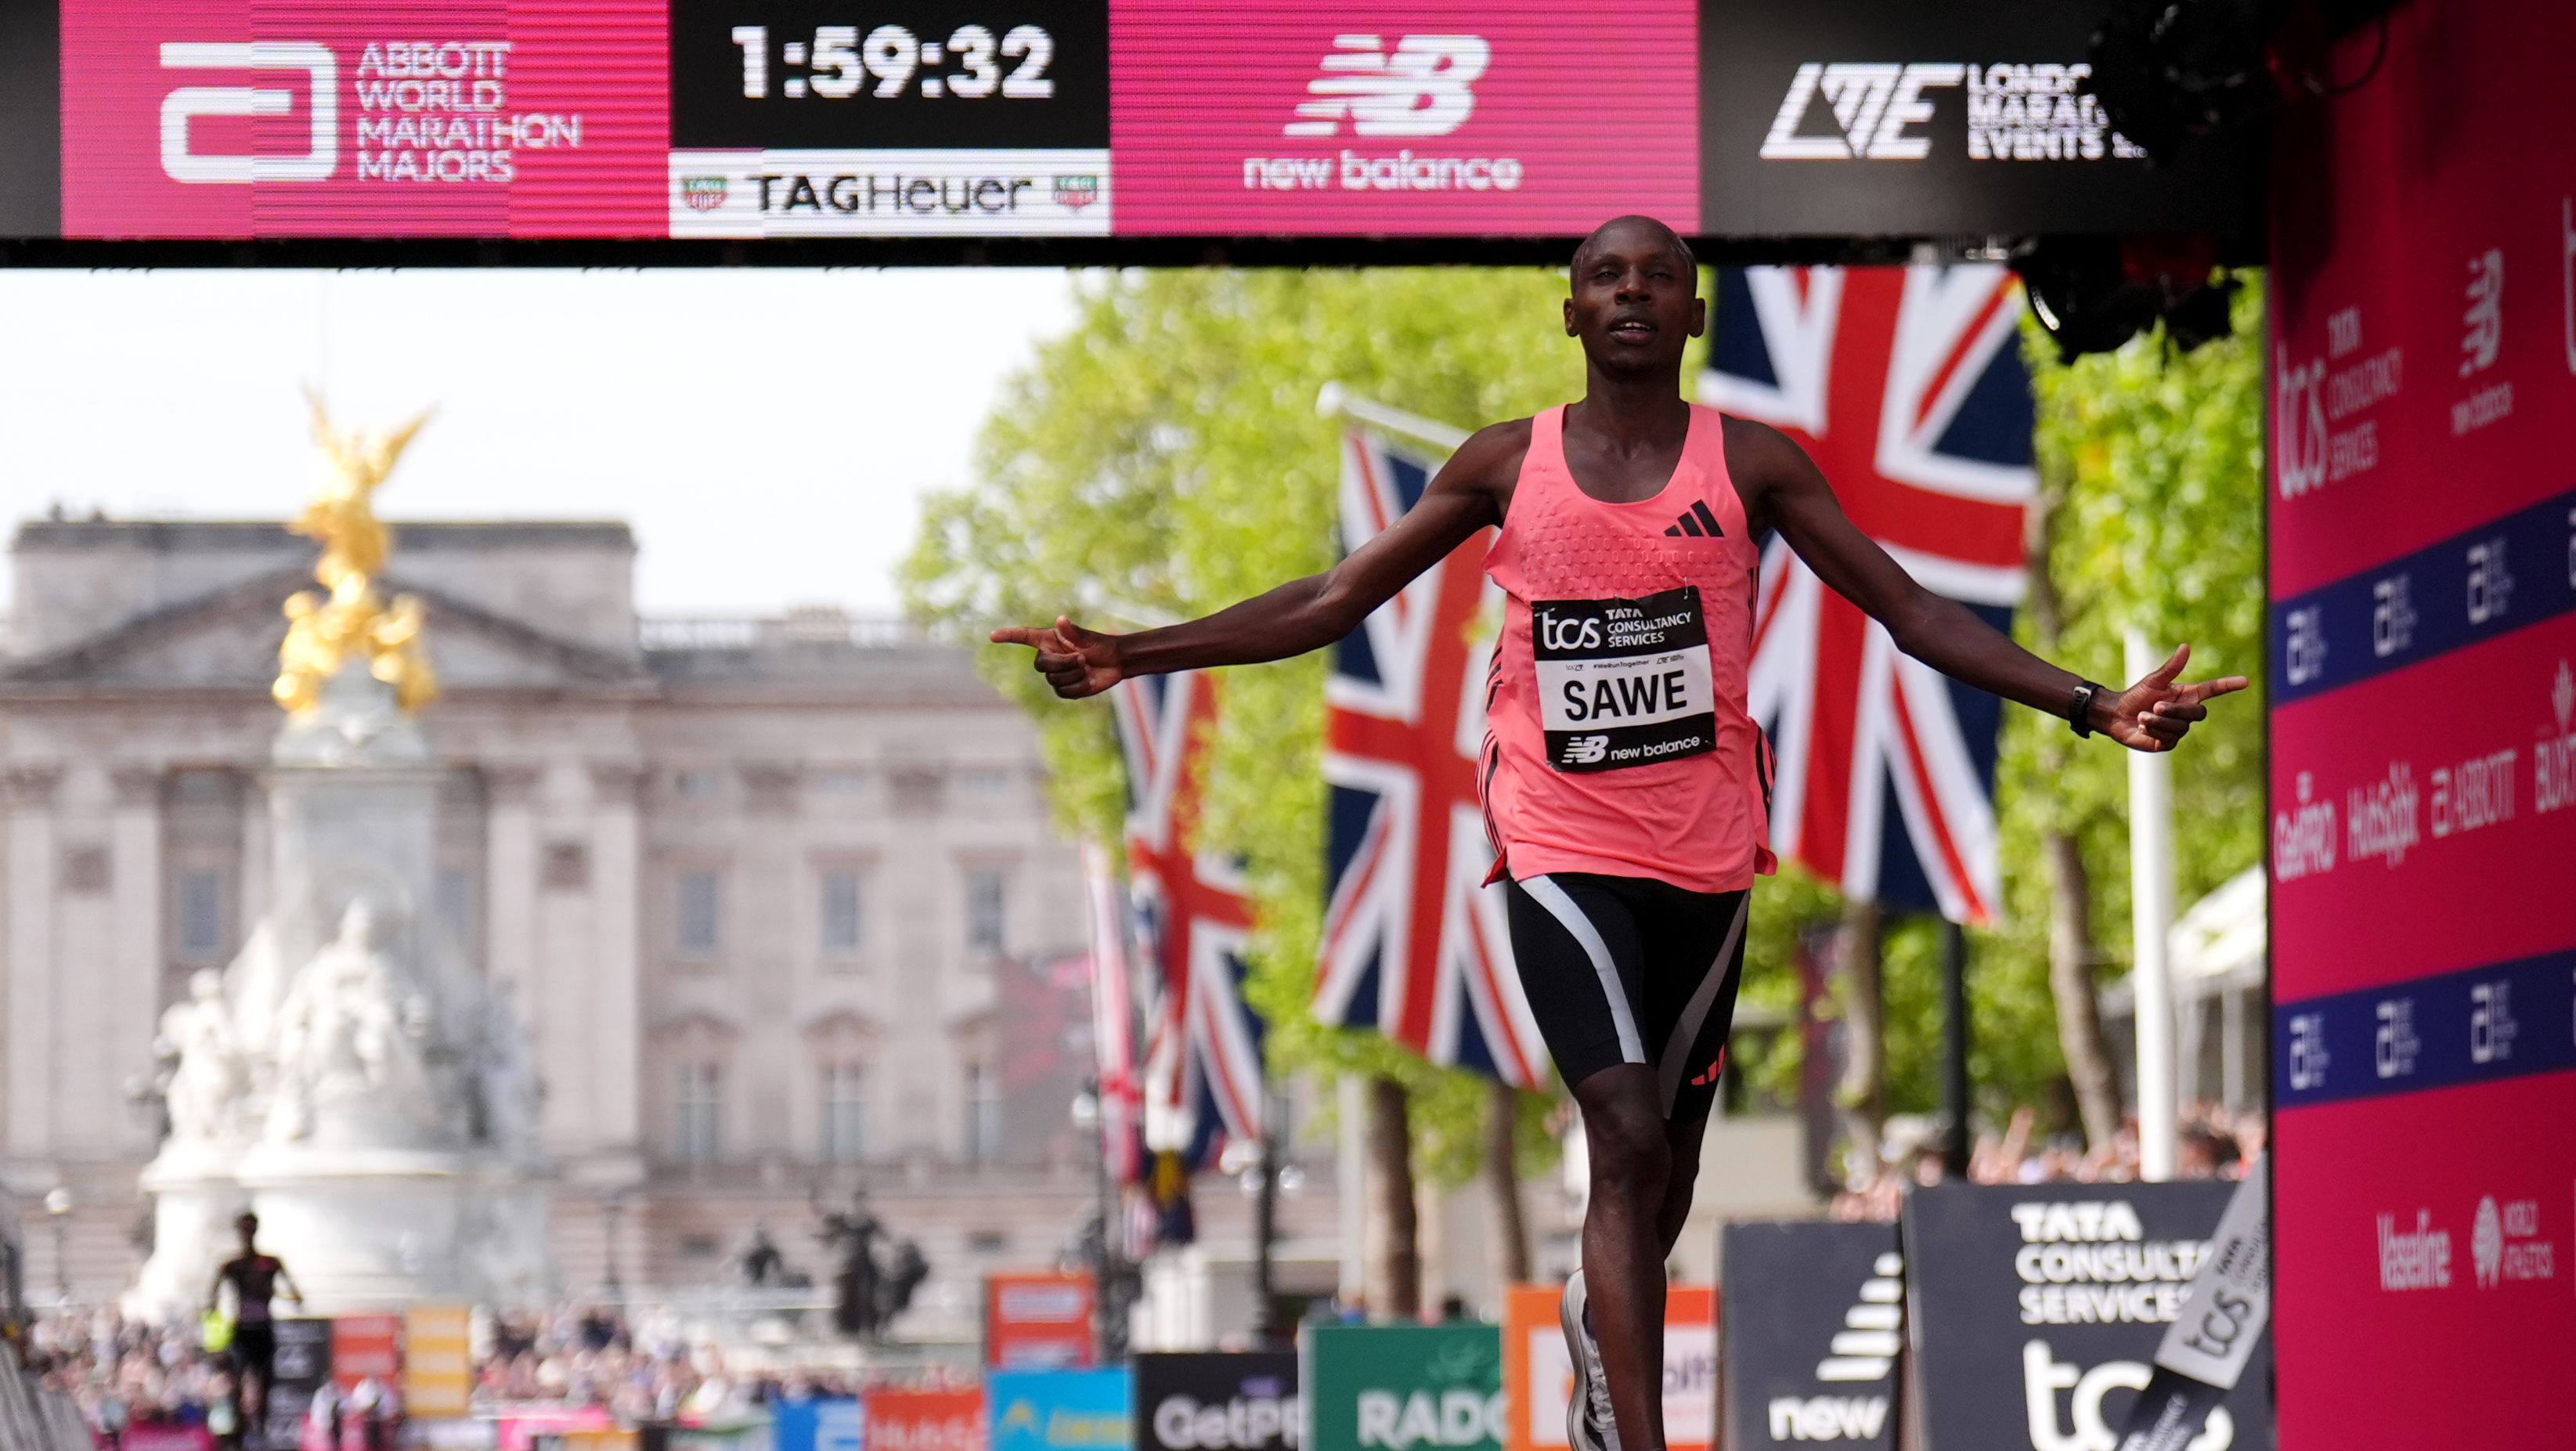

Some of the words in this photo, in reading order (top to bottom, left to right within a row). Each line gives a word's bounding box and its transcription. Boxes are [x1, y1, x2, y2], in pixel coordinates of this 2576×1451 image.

[357, 42, 514, 78] ABBOTT
[731, 24, 1055, 99] 1:59:32
[356, 80, 503, 112] WORLD
[357, 114, 583, 149] MARATHON
[1968, 127, 2105, 160] EVENTS
[357, 150, 517, 182] MAJORS
[1243, 157, 1331, 189] new
[1340, 150, 1523, 189] balance
[2276, 341, 2326, 501] tcs
[1542, 611, 1600, 650] tcs
[1605, 608, 1643, 620] TATA
[1607, 611, 1692, 634] CONSULTANCY
[1607, 631, 1665, 648] SERVICES
[1564, 670, 1687, 721] SAWE
[1611, 747, 1641, 761] new
[1643, 735, 1701, 757] balance
[2011, 1201, 2143, 1242] TATA
[1768, 1396, 1890, 1441] new
